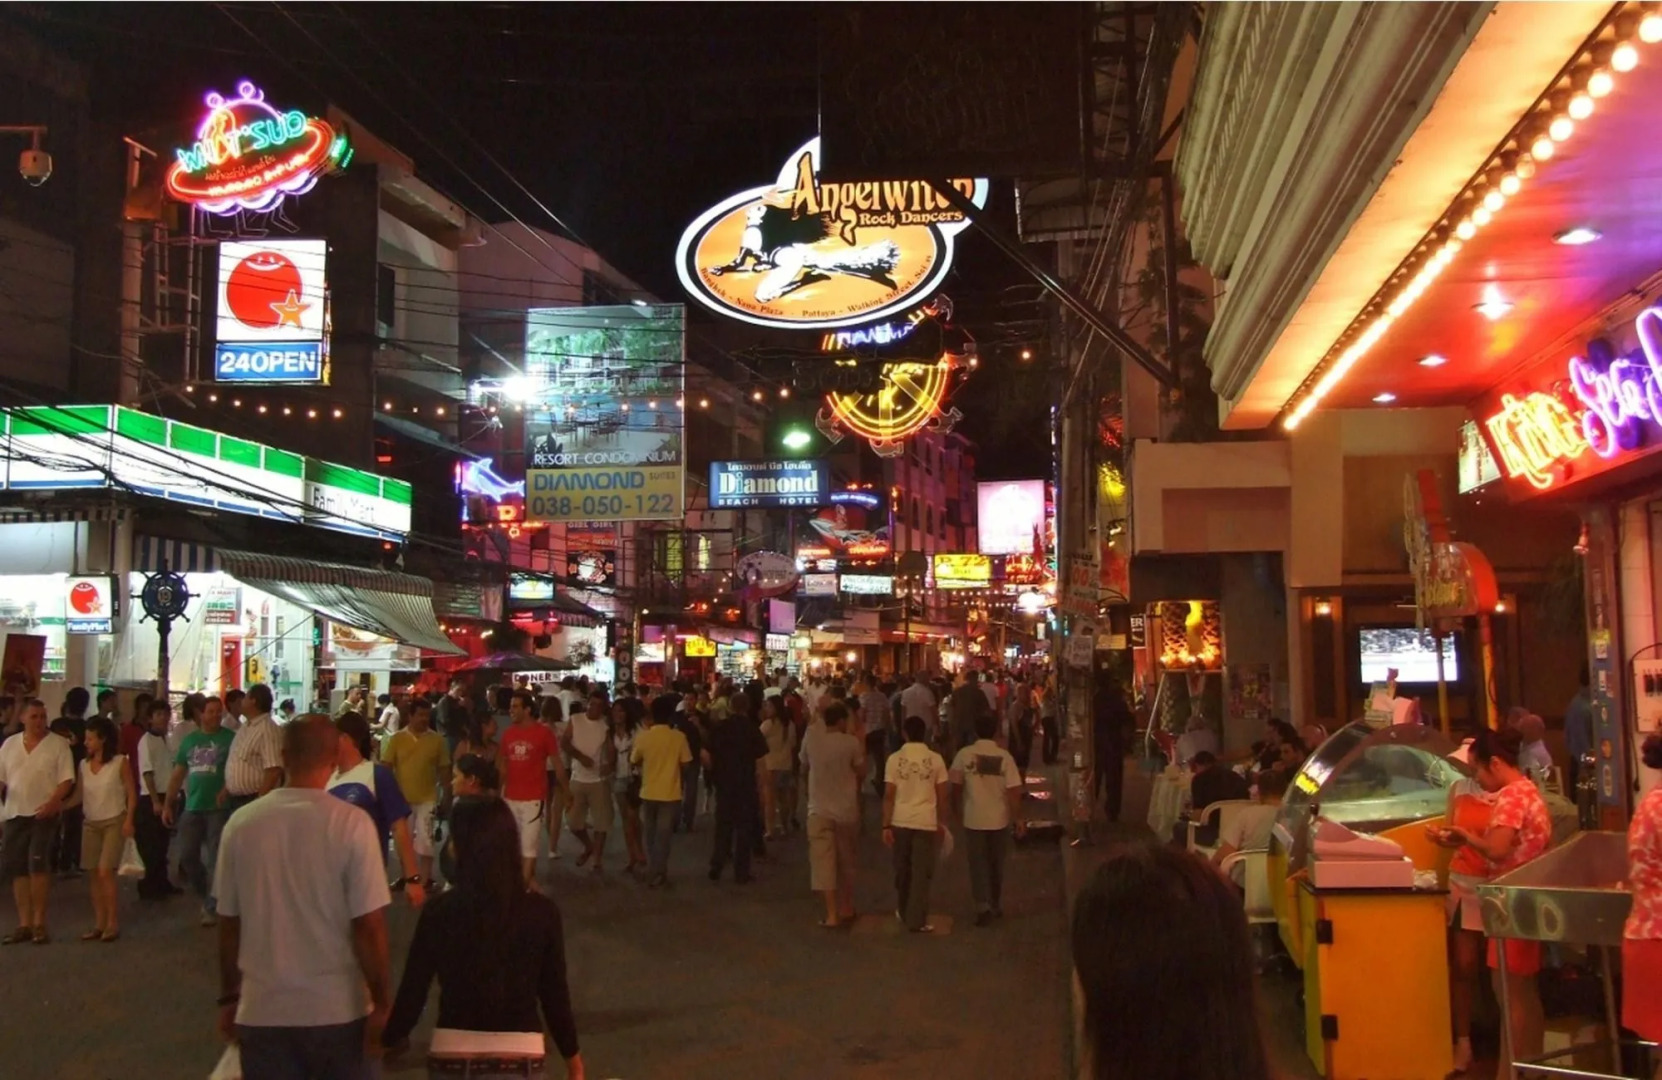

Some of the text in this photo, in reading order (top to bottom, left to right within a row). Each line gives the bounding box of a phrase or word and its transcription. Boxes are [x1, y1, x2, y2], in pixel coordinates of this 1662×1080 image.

[859, 210, 963, 227] Rock Dancers
[760, 306, 784, 315] Plaza
[534, 453, 579, 466] RESORT
[533, 471, 645, 491] DIAMOND
[719, 470, 819, 494] Diamond
[532, 493, 674, 517] 038-050-122
[719, 497, 819, 506] BEACH HOTEL
